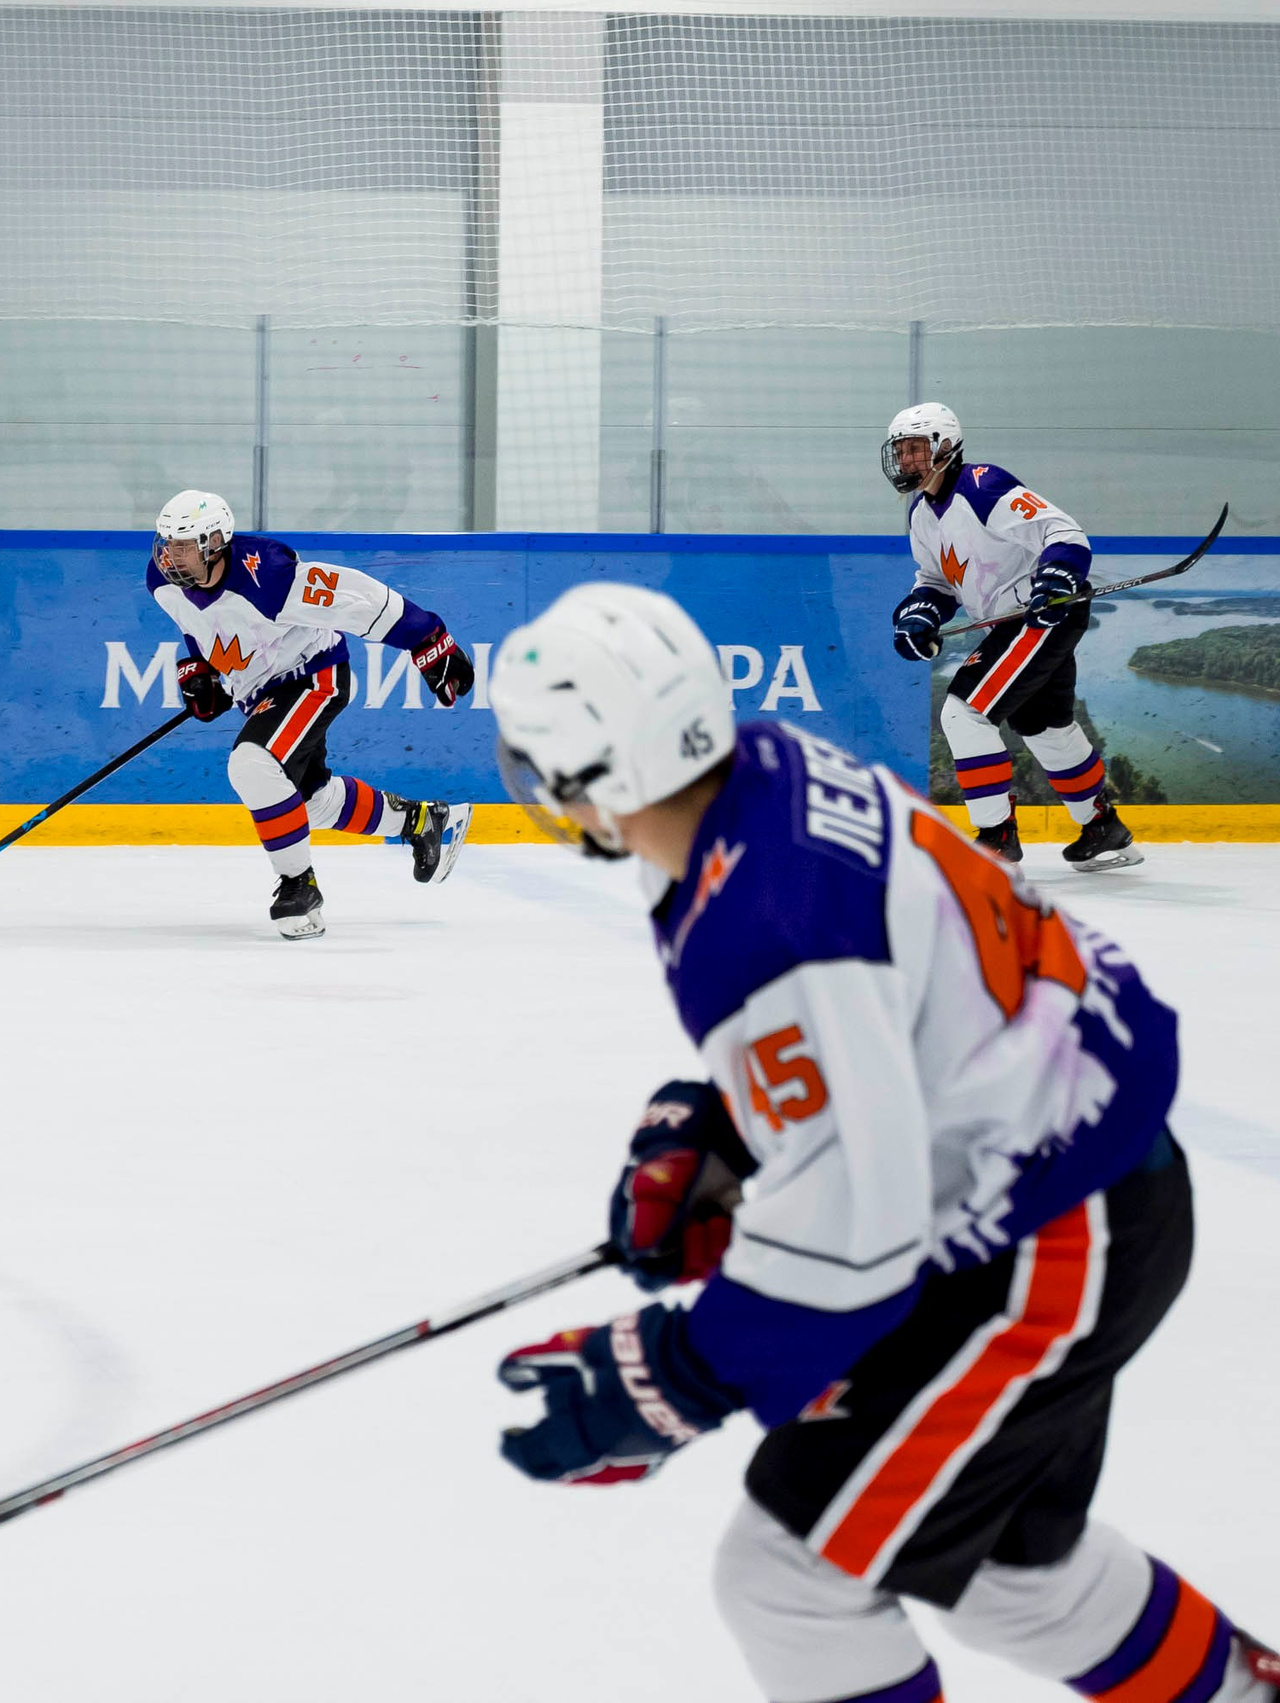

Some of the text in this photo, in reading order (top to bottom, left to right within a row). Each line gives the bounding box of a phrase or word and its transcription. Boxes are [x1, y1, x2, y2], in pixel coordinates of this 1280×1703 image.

[1010, 492, 1047, 520] 30
[302, 567, 339, 607] 52
[416, 634, 456, 669] BAUE
[716, 644, 823, 711] РА
[681, 716, 714, 760] 45
[728, 1023, 829, 1133] 45
